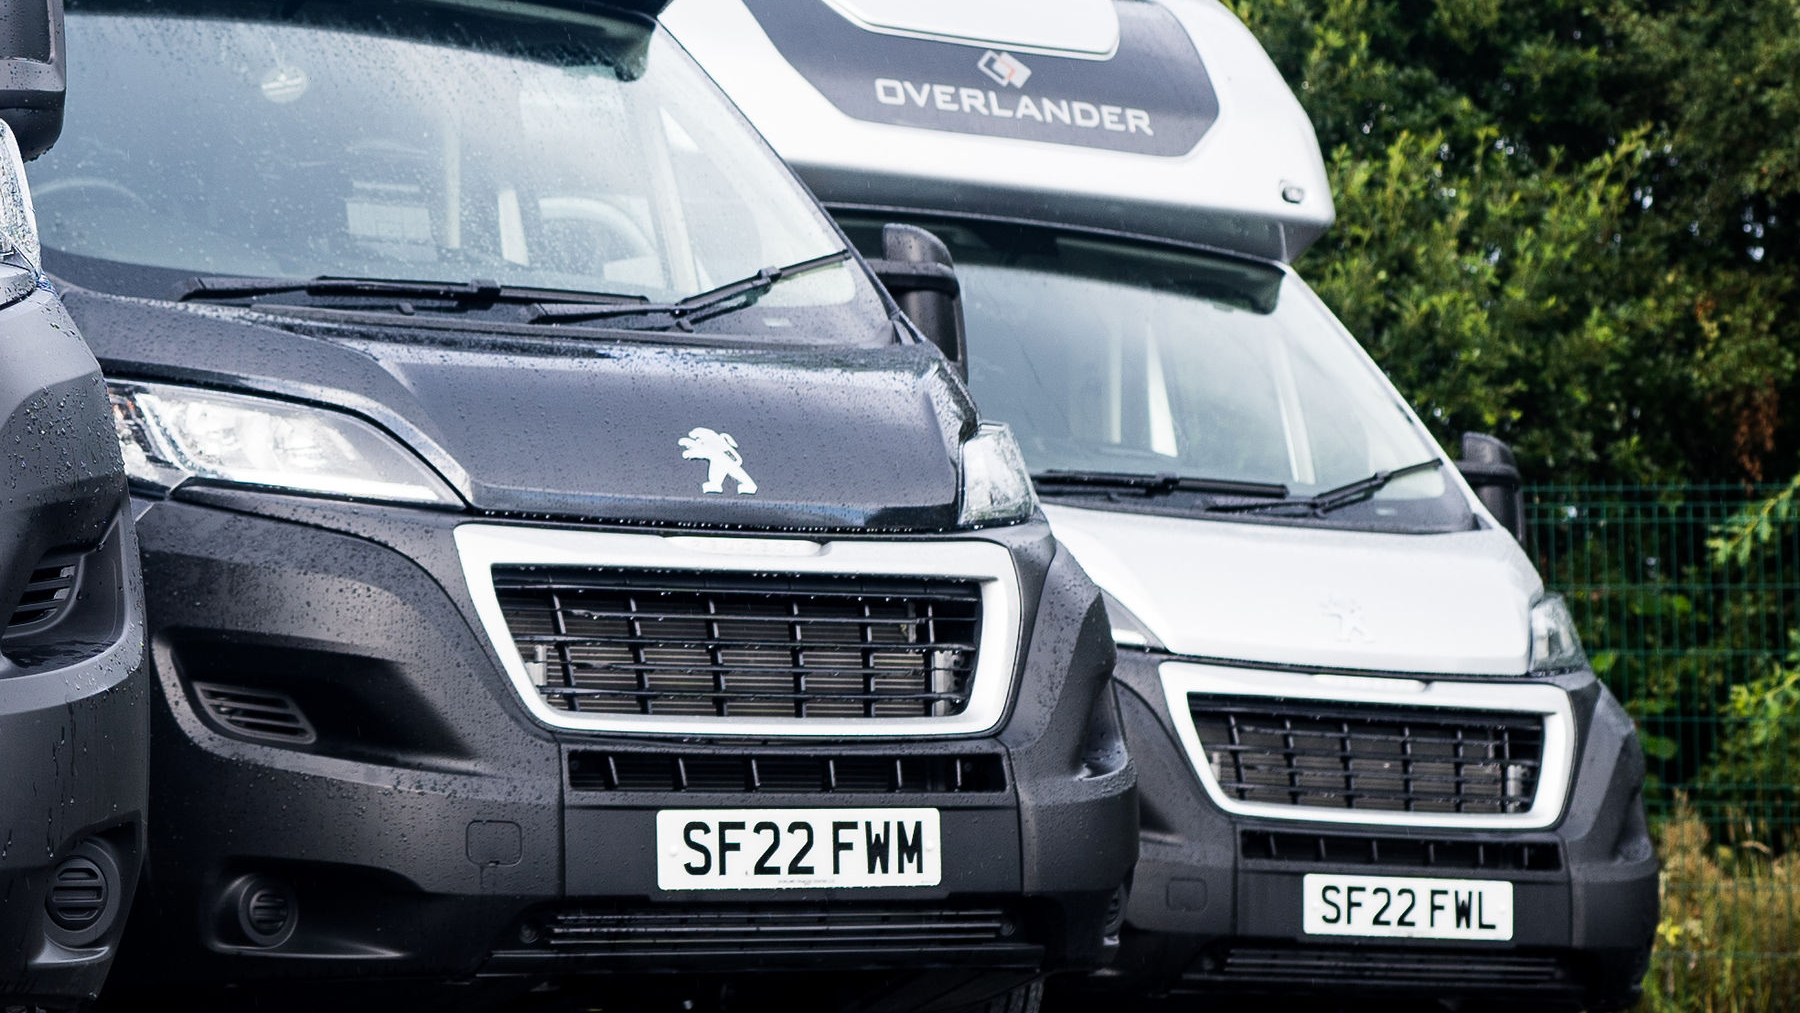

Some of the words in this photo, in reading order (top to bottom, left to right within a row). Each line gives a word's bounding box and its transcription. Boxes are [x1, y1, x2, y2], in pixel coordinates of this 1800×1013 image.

[874, 77, 1154, 136] OVERLANDER
[683, 820, 815, 876] SF22
[832, 820, 924, 875] FWM
[1321, 884, 1416, 927] SF22
[1430, 889, 1497, 930] FWL
